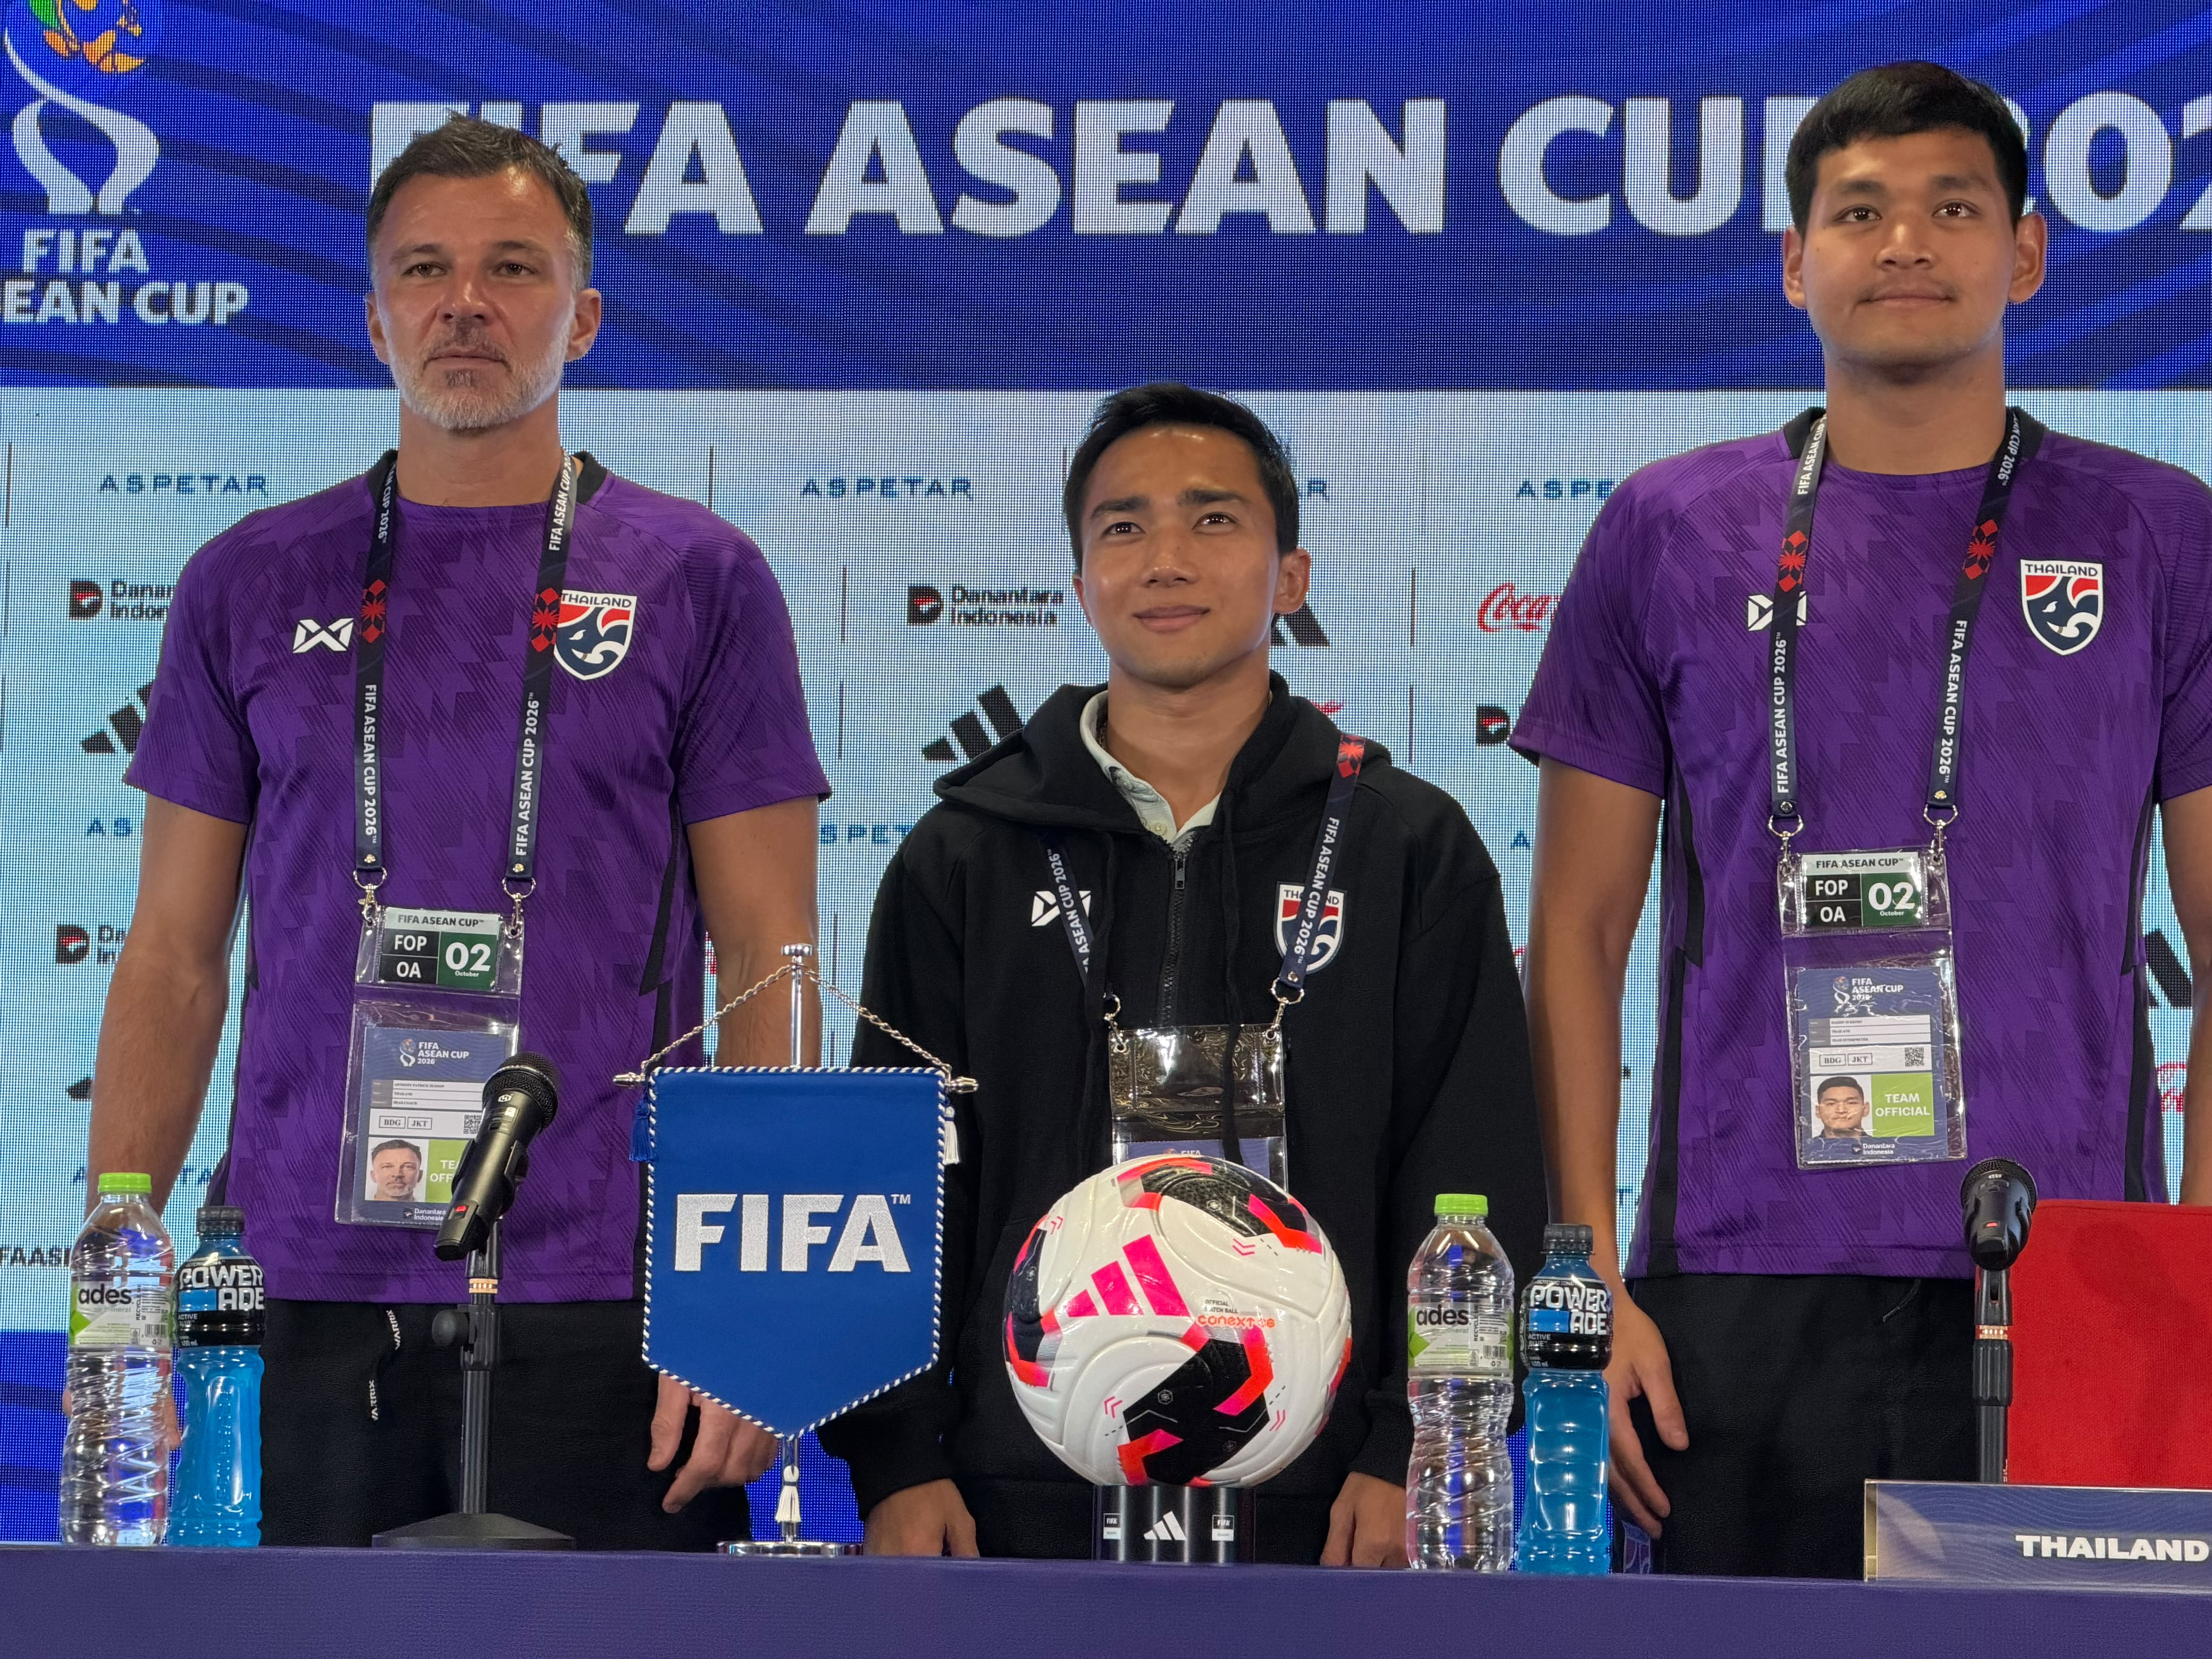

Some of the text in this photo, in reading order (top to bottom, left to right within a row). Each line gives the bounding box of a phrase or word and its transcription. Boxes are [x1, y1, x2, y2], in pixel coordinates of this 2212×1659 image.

[803, 95, 1447, 238] ASEAN
[23, 229, 149, 272] FIFA
[1, 280, 249, 324] EAN CUP
[1803, 440, 1821, 471] ASEAN
[2007, 434, 2020, 456] CUP
[99, 475, 266, 493] ASPETAR
[560, 469, 572, 491] CUP
[802, 477, 973, 499] ASPETAR
[1517, 480, 1615, 500] ASPE
[1797, 472, 1812, 495] FIFA
[381, 485, 392, 509] CUP
[553, 490, 569, 526] ASEAN
[548, 527, 563, 551] FIFA
[2025, 563, 2098, 577] THAILAND
[562, 593, 632, 608] THAILAND
[951, 585, 1064, 604] Danantara
[951, 609, 1058, 627] Indonesia
[1951, 619, 1967, 650] FIFA
[1773, 676, 1786, 706] CUP
[1946, 653, 1962, 703] ASEAN
[364, 684, 377, 713] FIFA
[1774, 708, 1788, 758] ASEAN
[1943, 706, 1957, 736] CUP
[363, 715, 376, 764] ASEAN
[522, 738, 535, 768] CUP
[363, 766, 376, 795] CUP
[1777, 761, 1789, 793] FIFA
[518, 770, 533, 821] ASEAN
[515, 824, 530, 856] FIFA
[1323, 817, 1340, 843] FIFA
[1311, 844, 1332, 891] ASEAN
[1816, 860, 1838, 868] FIFA
[1841, 858, 1876, 868] ASEAN
[1058, 884, 1075, 909] CUP
[1815, 879, 1849, 896] FOP
[1868, 882, 1915, 911] 02
[1305, 891, 1321, 919] CUP
[1820, 906, 1846, 923] OA
[398, 914, 420, 924] FIFA
[422, 916, 457, 926] ASEAN
[1066, 909, 1091, 953] ASEAN
[394, 934, 428, 952] FOP
[396, 961, 422, 978] OA
[445, 942, 491, 972] 02
[417, 1050, 449, 1058] ASEAN
[1884, 1093, 1920, 1104] TEAM
[1875, 1107, 1931, 1117] OFFICIAL
[179, 1264, 264, 1290] POWER
[218, 1287, 265, 1311] ADE
[1530, 1285, 1607, 1312] POWER
[1570, 1311, 1609, 1336] ADE
[2015, 1535, 2209, 1562] THAILAND
